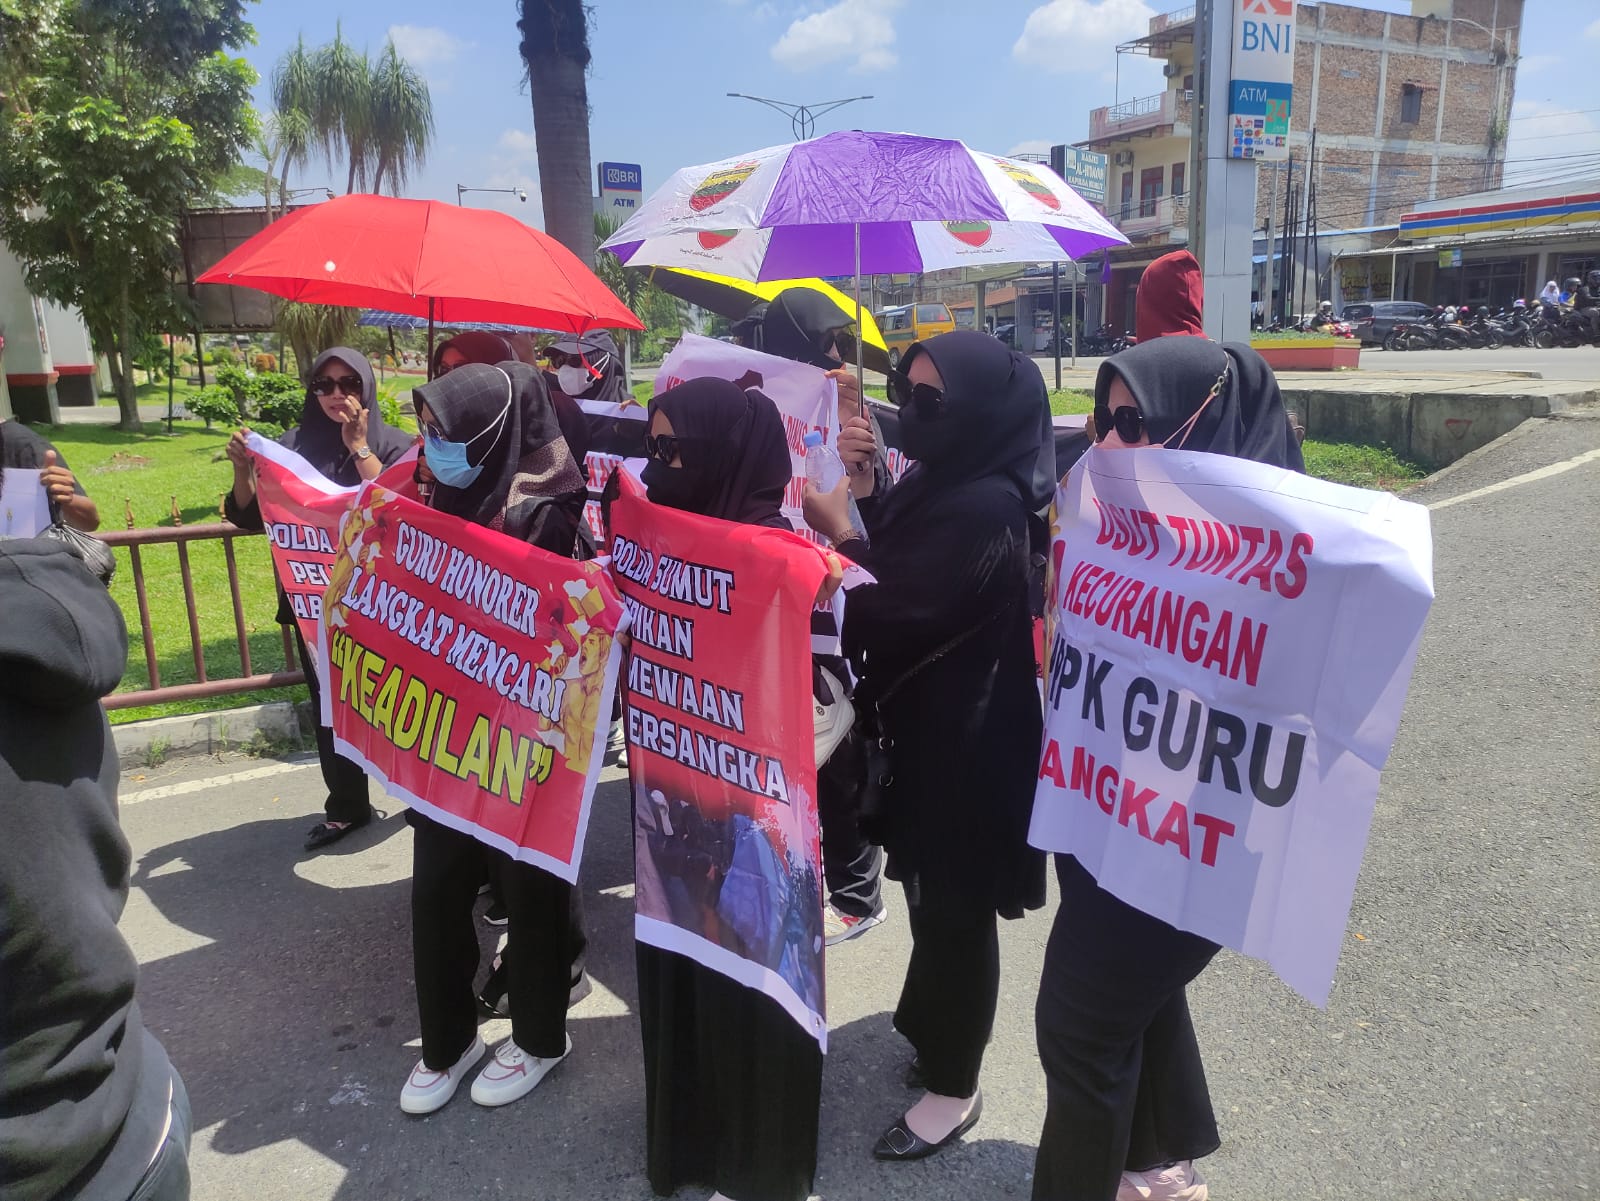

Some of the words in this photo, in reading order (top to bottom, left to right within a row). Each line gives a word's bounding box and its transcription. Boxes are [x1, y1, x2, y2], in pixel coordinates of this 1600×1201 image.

[1242, 20, 1291, 54] BNI
[1239, 88, 1267, 102] ATM
[1266, 100, 1287, 122] 24
[613, 198, 635, 208] ATM
[620, 171, 638, 183] BRI
[263, 521, 337, 554] POLDA
[612, 534, 656, 588] POLDA
[650, 554, 736, 615] SUMUT
[1093, 497, 1160, 561] USUT
[1166, 514, 1315, 600] TUNTAS
[395, 521, 443, 591] GURU
[440, 548, 540, 638] HONORER
[340, 565, 455, 655] LANGKAT
[445, 623, 566, 723] MENCARI
[1062, 560, 1269, 687] KECURANGAN
[1122, 676, 1307, 808] GURU
[1038, 735, 1236, 867] ANGKAT
